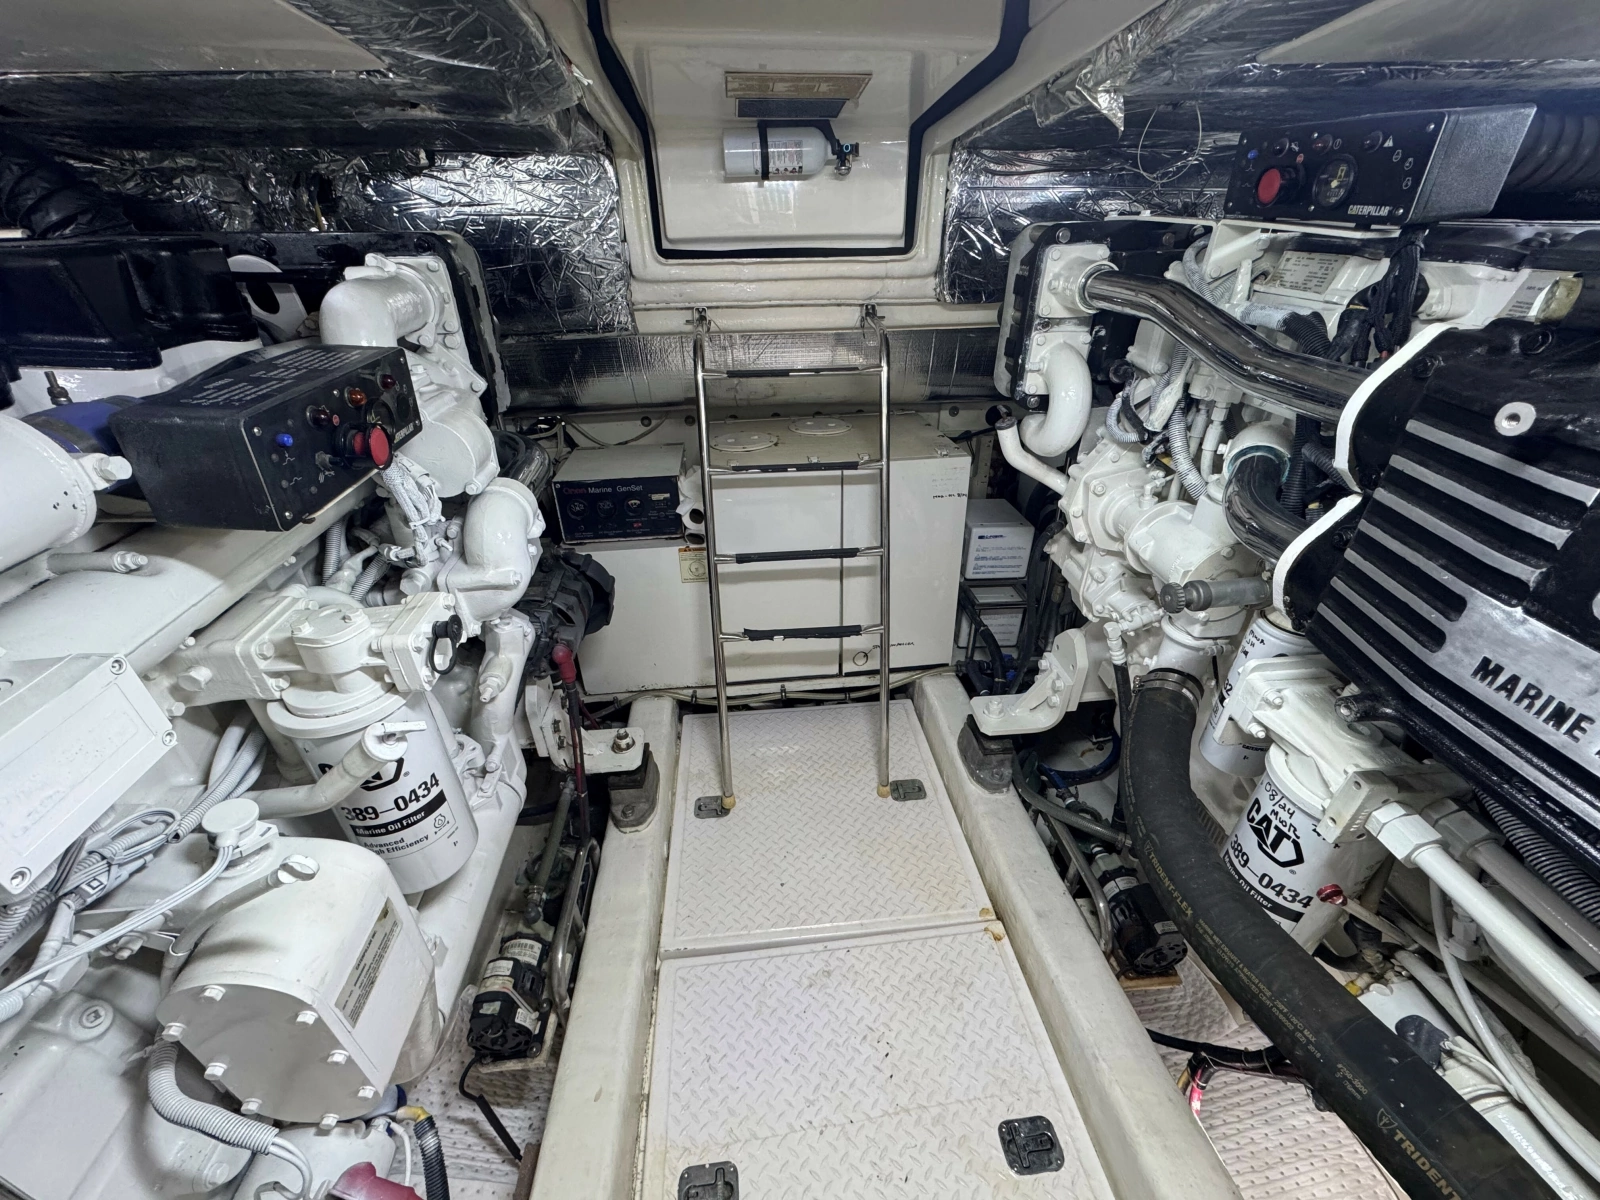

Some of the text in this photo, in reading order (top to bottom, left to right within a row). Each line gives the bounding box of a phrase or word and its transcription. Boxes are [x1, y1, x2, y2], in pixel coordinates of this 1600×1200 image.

[1347, 204, 1390, 217] CATERPILLAR
[588, 486, 612, 494] Marine
[616, 484, 643, 493] GenSet
[1470, 655, 1596, 744] MARINE
[341, 772, 440, 822] 389-0434
[1264, 781, 1296, 819] 08/24
[356, 811, 426, 836] Marine Oil Filter
[1247, 797, 1295, 856] CAT
[364, 837, 405, 849] Advanced
[386, 834, 429, 854] Efficiency
[1149, 853, 1194, 918] TRIDENT-FLEX
[1230, 834, 1314, 909] 389-0434
[1249, 890, 1273, 908] Filter
[1220, 943, 1240, 964] EXHAUST
[1241, 966, 1259, 985] WATER
[1256, 981, 1272, 998] HOSE
[1257, 992, 1273, 1008] CERT
[1394, 1129, 1462, 1200] TRIDENT
